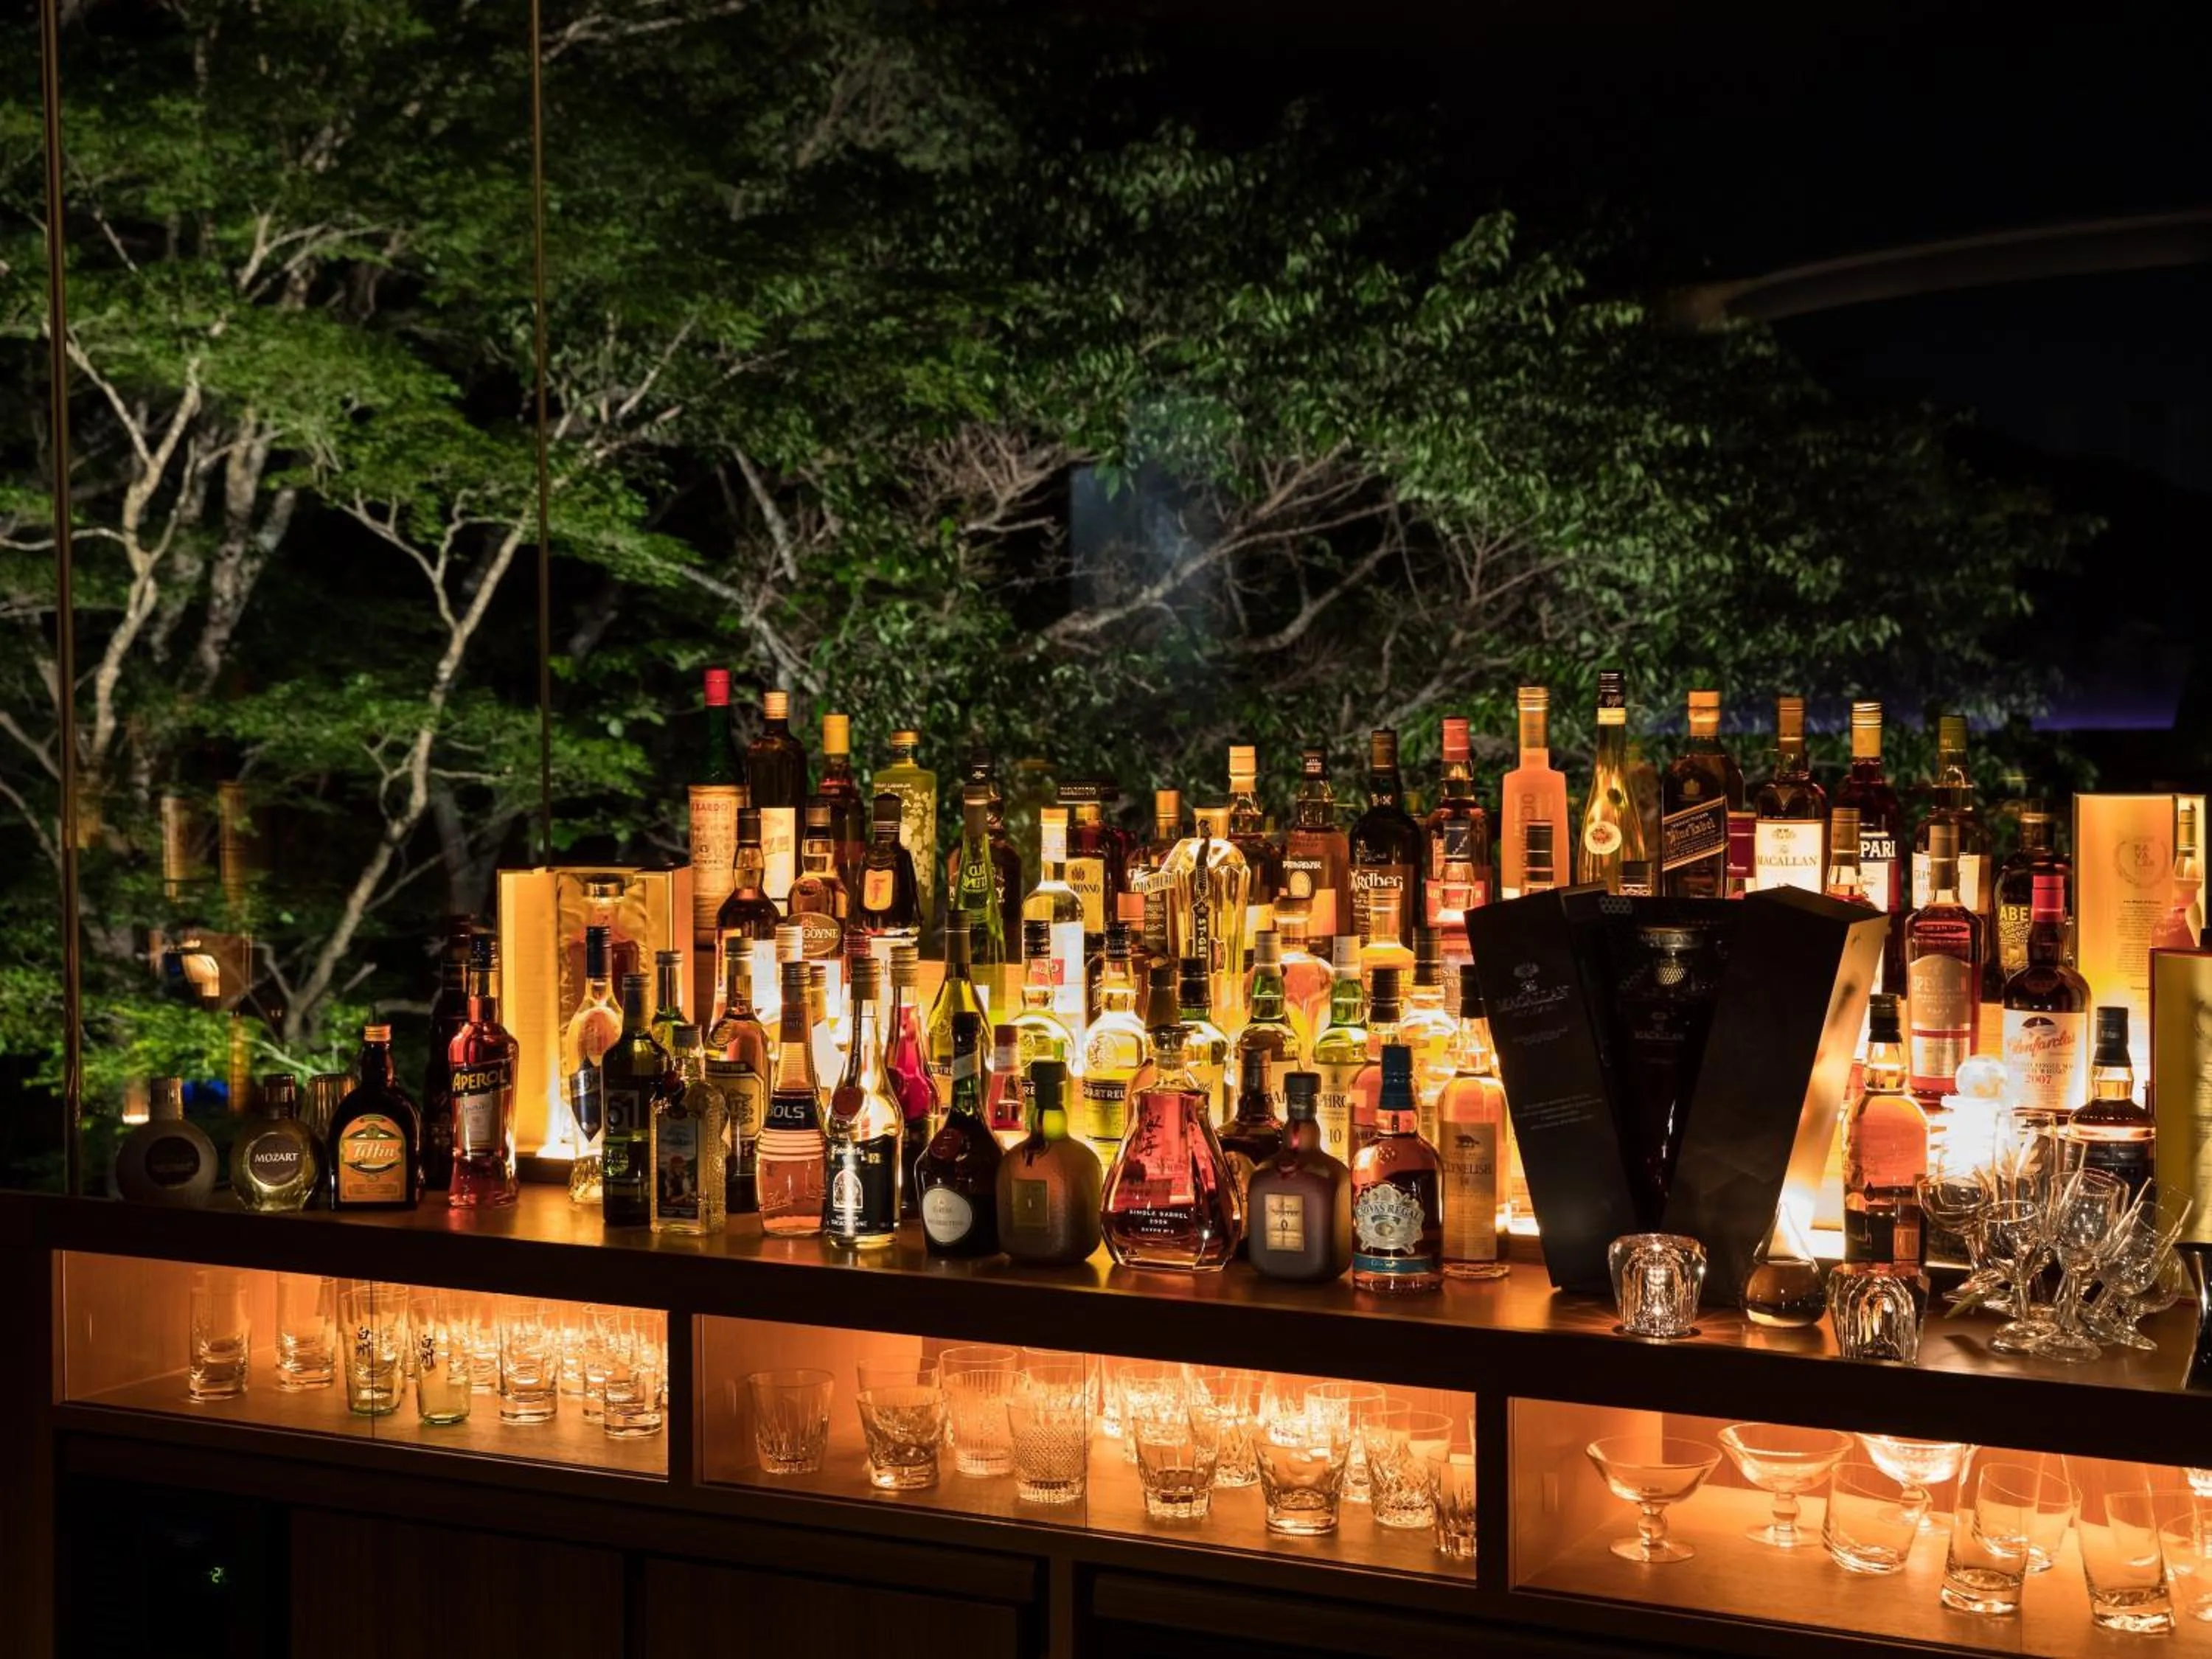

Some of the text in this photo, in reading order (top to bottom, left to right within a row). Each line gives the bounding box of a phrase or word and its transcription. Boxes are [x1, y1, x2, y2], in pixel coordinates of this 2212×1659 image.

[1860, 840, 1896, 858] PARI
[1757, 855, 1818, 866] MACALLAN
[2000, 906, 2028, 921] ABE
[802, 928, 838, 939] GOYNE
[452, 1070, 508, 1092] APEROL
[254, 1152, 299, 1164] MOZART
